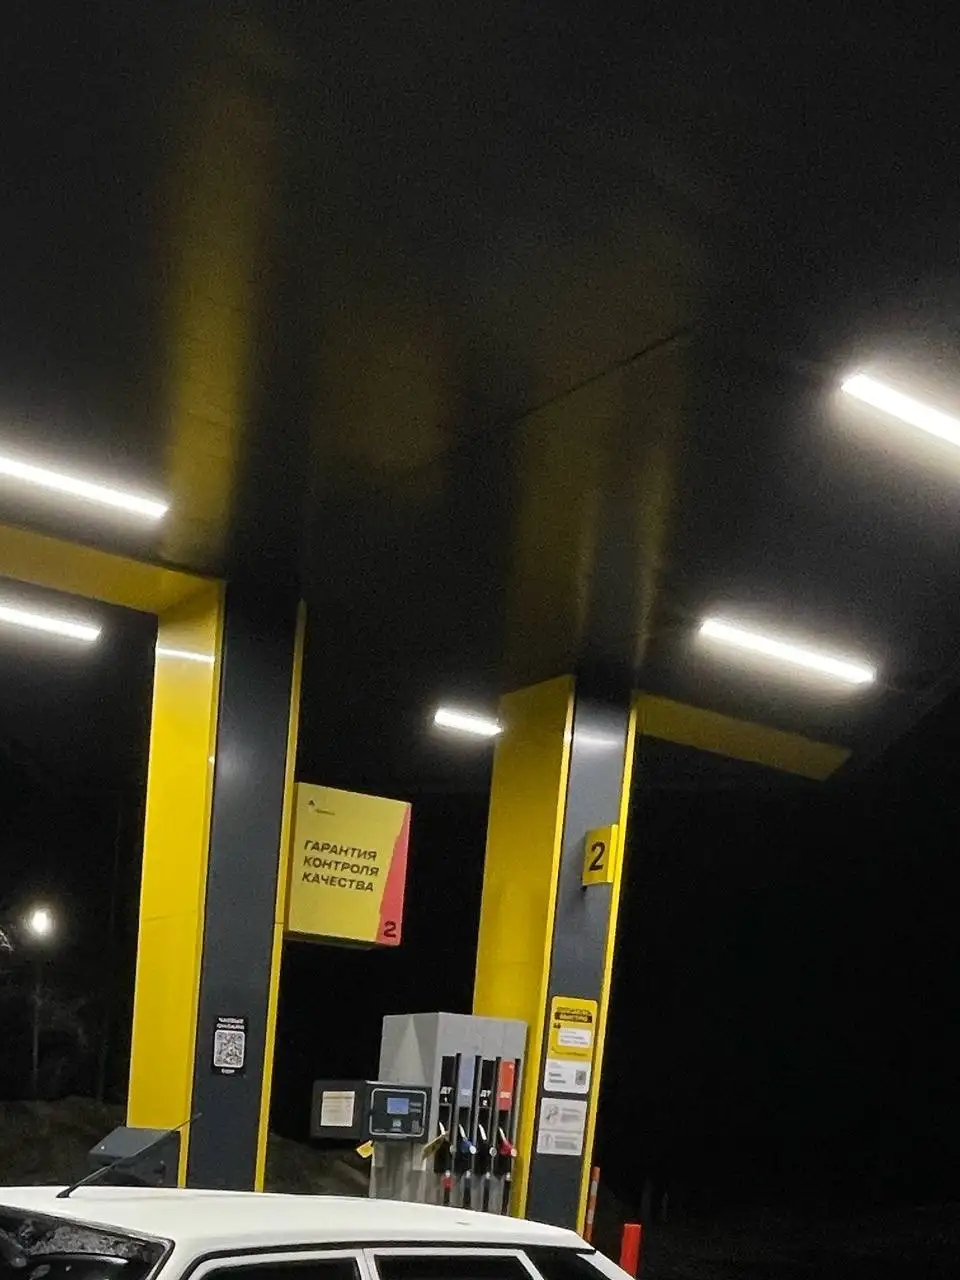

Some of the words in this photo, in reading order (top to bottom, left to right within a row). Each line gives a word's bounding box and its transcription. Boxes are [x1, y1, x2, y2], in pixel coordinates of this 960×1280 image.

[304, 840, 377, 861] ГАРАНТИЯ
[589, 842, 605, 871] 2
[303, 856, 380, 877] КОНТРОЛЯ
[302, 872, 374, 892] КАЧЕСТВА
[383, 920, 397, 938] 2
